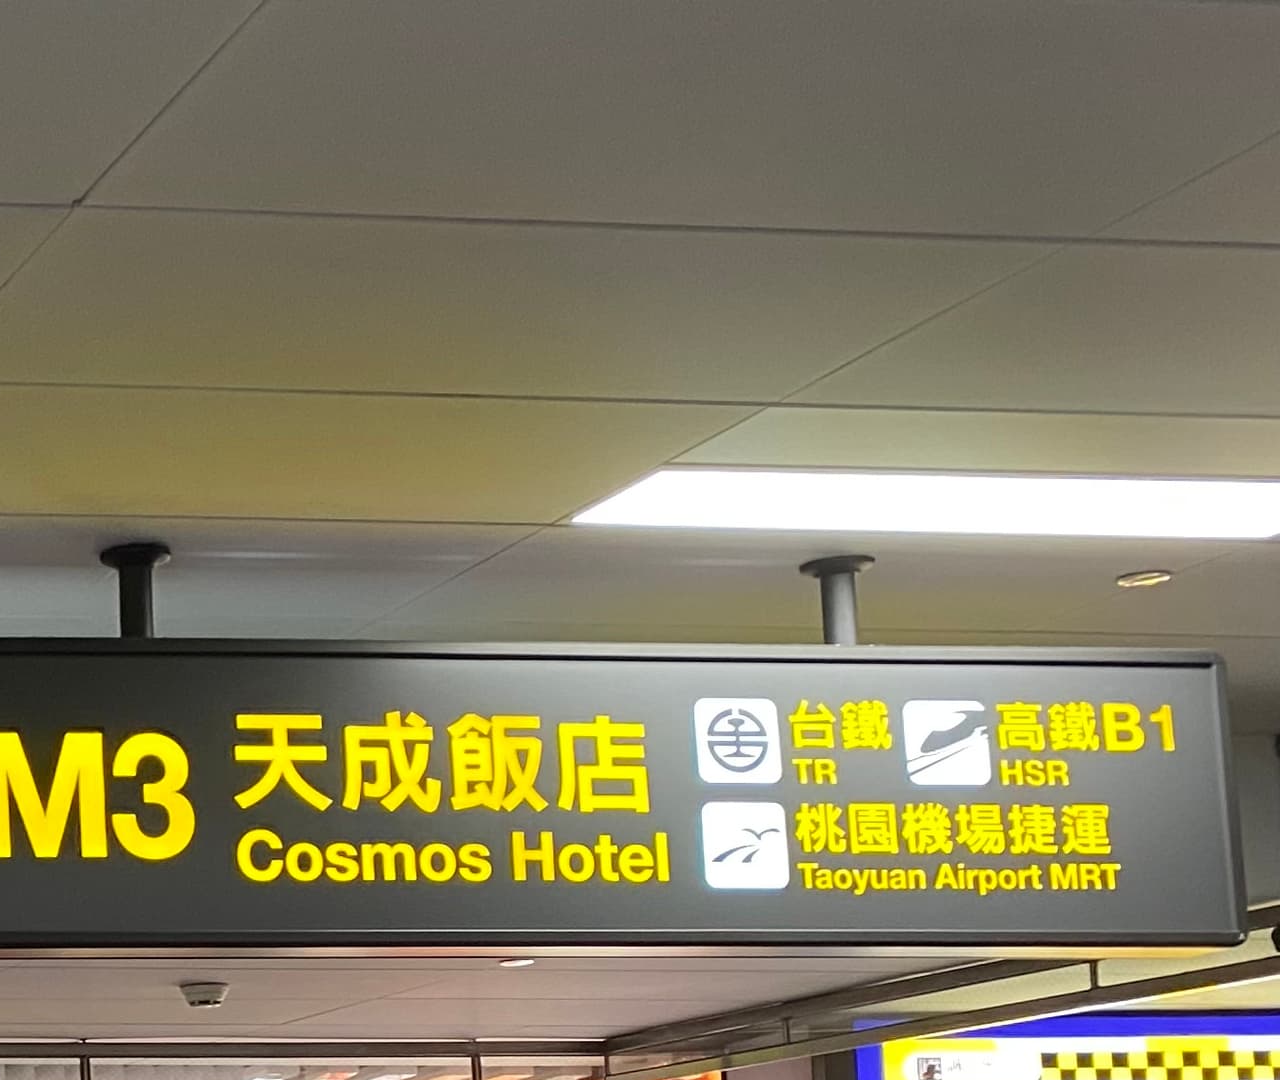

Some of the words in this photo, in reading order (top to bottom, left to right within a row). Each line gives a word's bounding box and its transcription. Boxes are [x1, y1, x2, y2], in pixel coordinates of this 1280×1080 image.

[789, 700, 893, 752] 台鐵
[996, 701, 1176, 754] 高鐵B1
[233, 711, 651, 814] 天成飯店
[791, 758, 838, 787] TR
[1000, 760, 1070, 787] HSR
[236, 829, 493, 884] Cosmos
[511, 831, 671, 883] Hotel
[795, 802, 1112, 857] 桃園機場捷運
[799, 863, 928, 895] Taoyuan
[934, 864, 1043, 896] Airport
[1050, 865, 1123, 892] MRT
